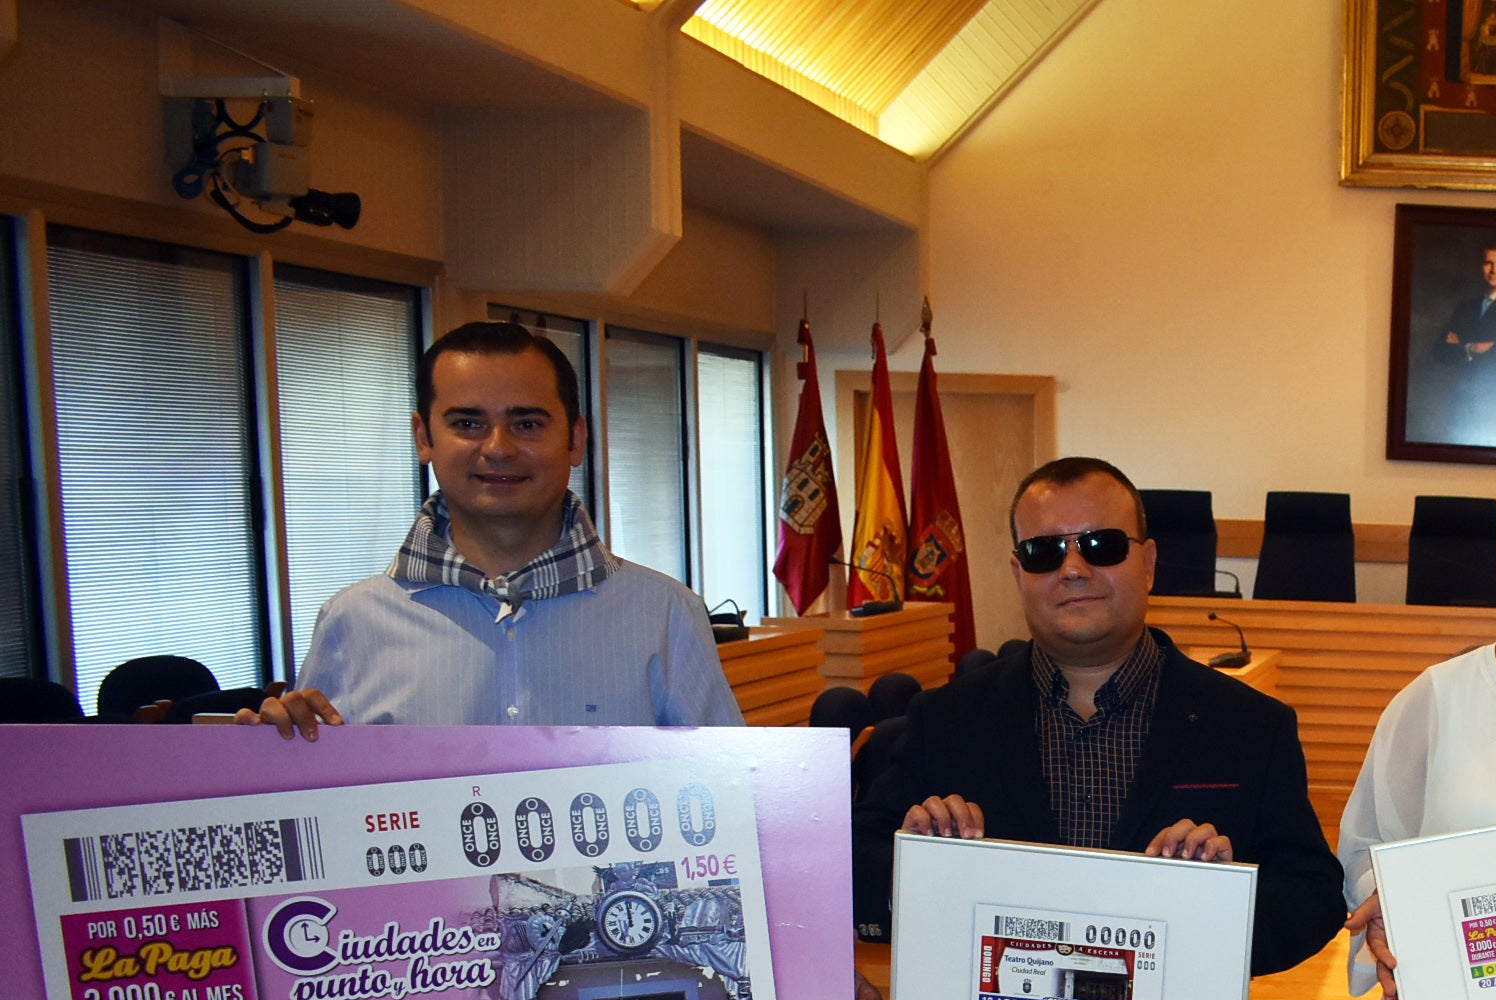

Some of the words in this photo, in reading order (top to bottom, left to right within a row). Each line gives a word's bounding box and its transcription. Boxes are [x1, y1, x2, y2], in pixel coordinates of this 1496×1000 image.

[472, 785, 481, 797] R
[365, 811, 420, 833] SERIE
[723, 854, 738, 875] €
[88, 920, 117, 940] POR
[123, 914, 167, 940] 0,50
[170, 916, 181, 932] €
[186, 908, 219, 930] MÁS
[266, 898, 473, 972] Ciudades
[477, 935, 497, 948] en
[1467, 929, 1485, 941] La
[1010, 941, 1052, 949] CIUDADES
[1087, 948, 1119, 956] ESCENA
[1469, 940, 1493, 953] 3.000
[81, 947, 139, 982] La
[140, 941, 238, 980] Paga
[982, 945, 993, 983] DOMINGO
[1004, 955, 1026, 964] Teatro
[1027, 957, 1054, 967] Quijano
[393, 979, 406, 996] y
[410, 957, 491, 990] hora
[1011, 966, 1033, 974] Ciudad
[1033, 968, 1047, 976] Real
[1480, 979, 1491, 988] 20
